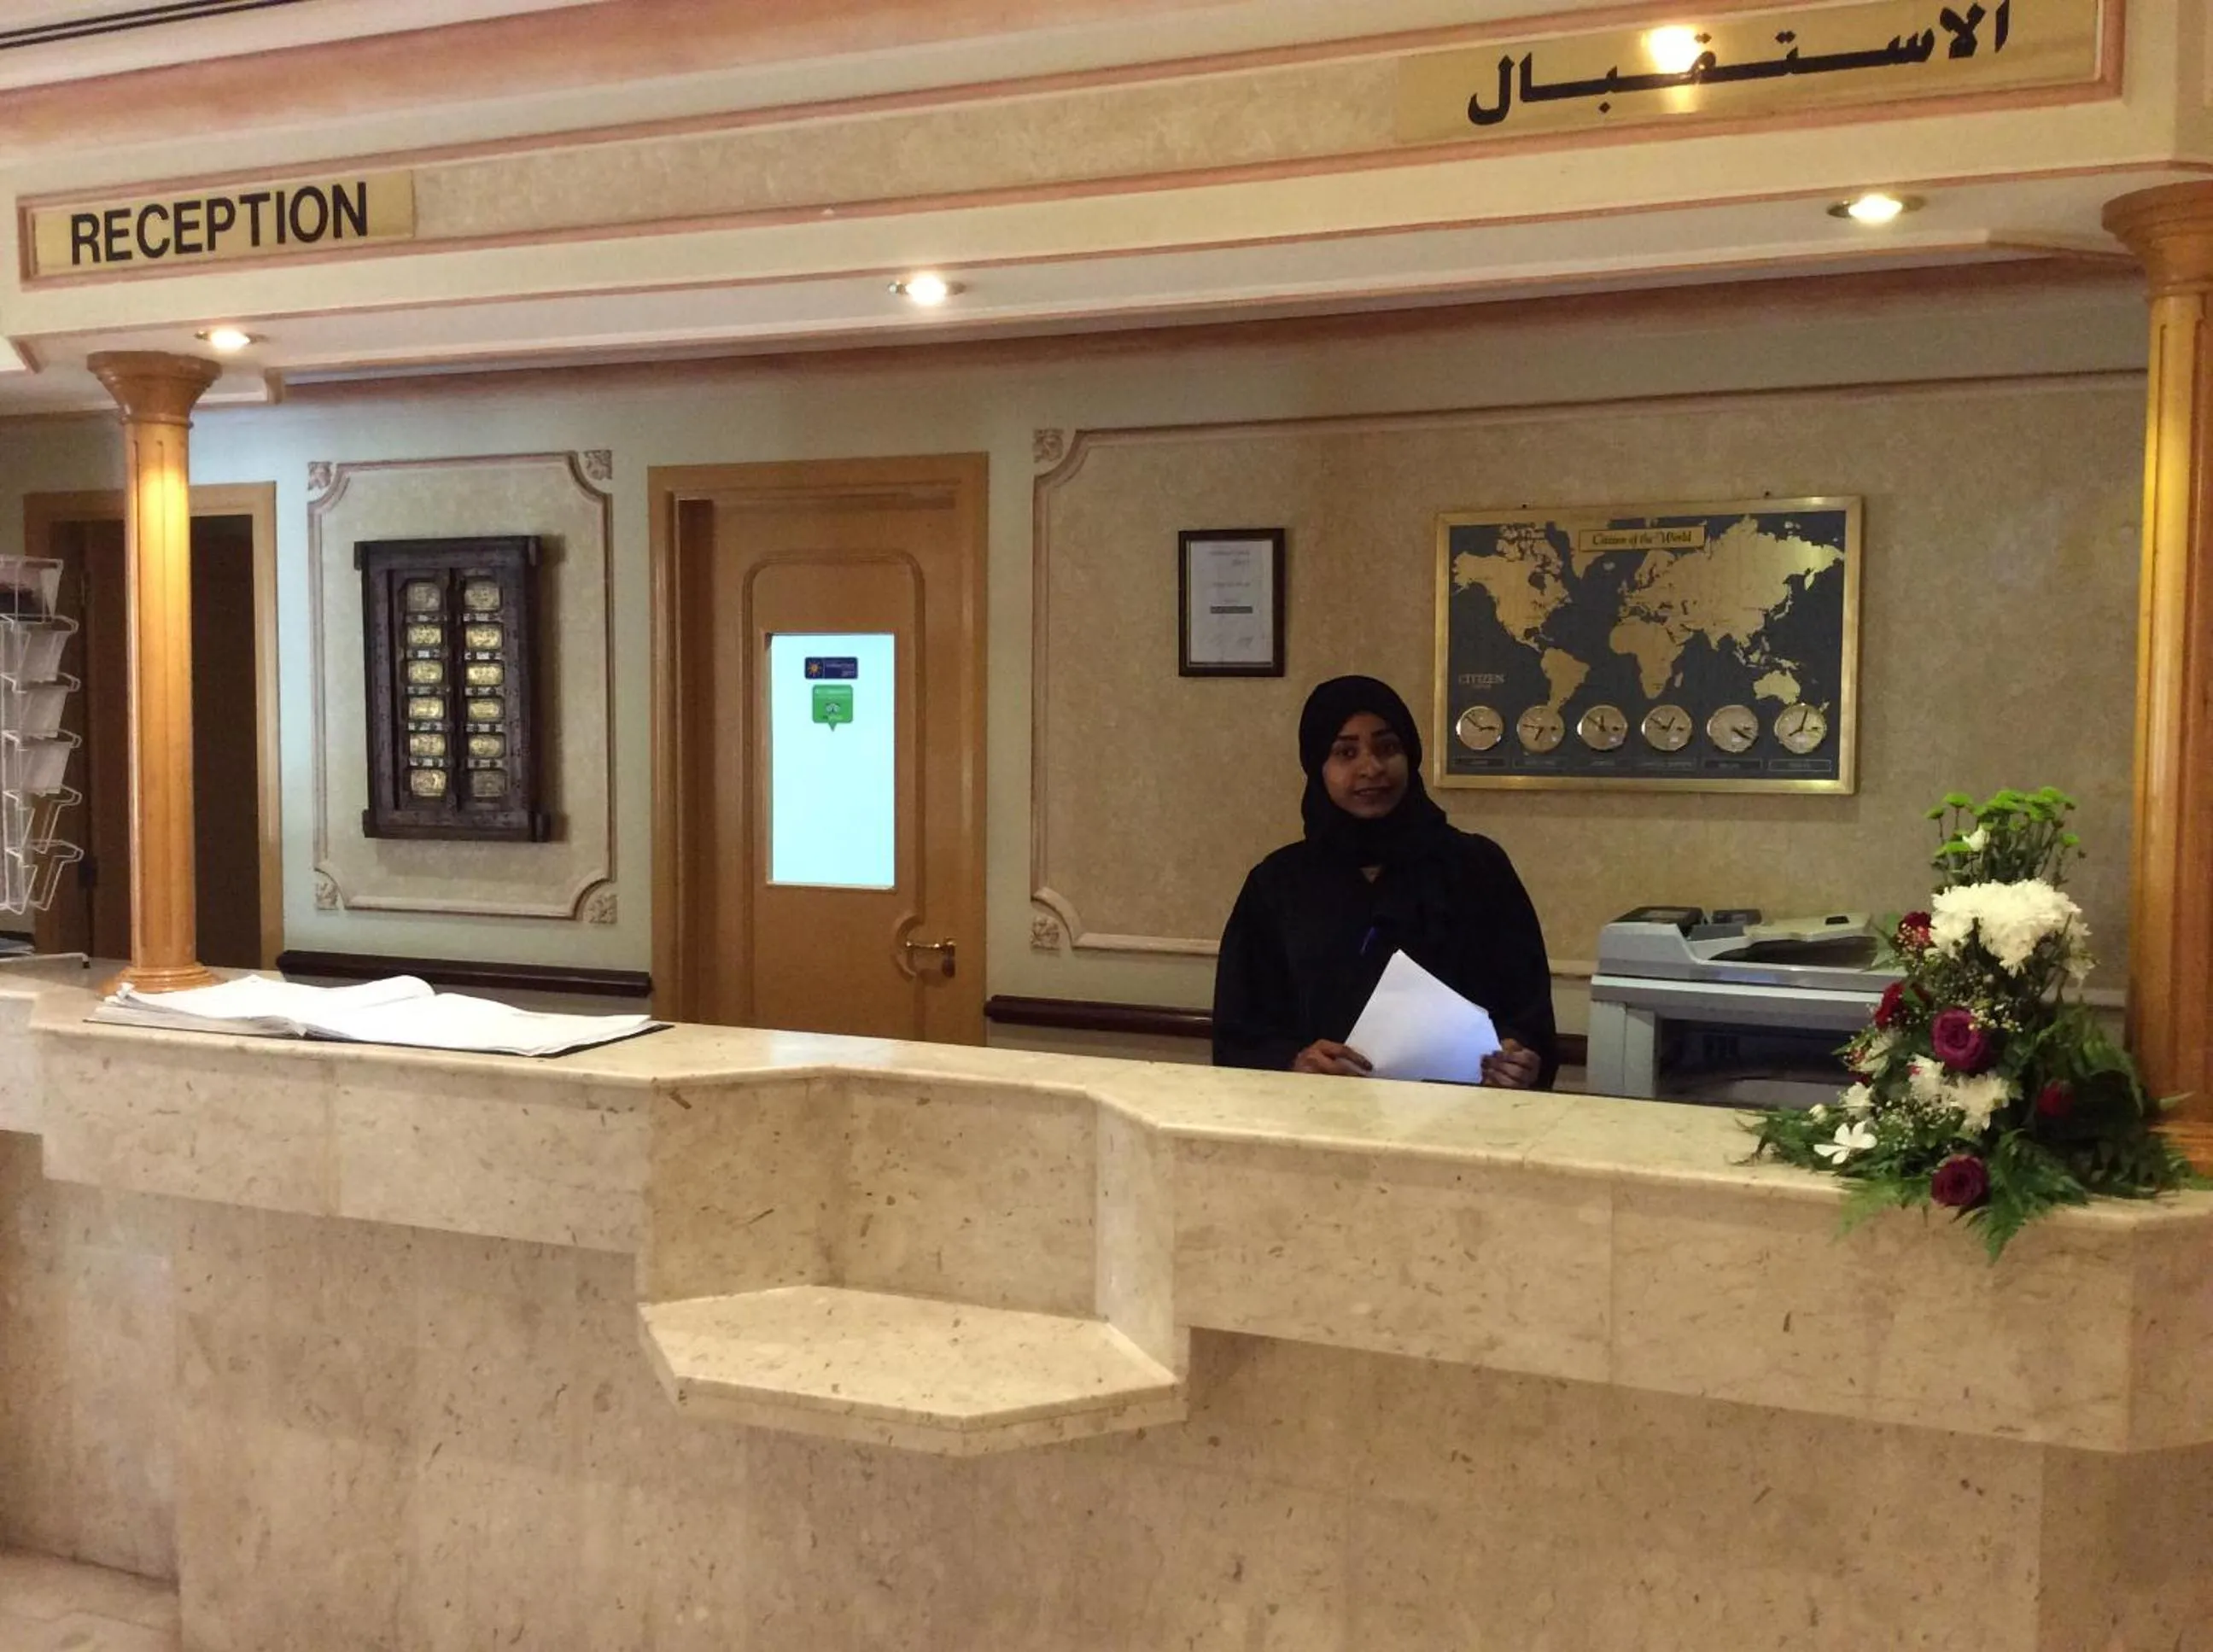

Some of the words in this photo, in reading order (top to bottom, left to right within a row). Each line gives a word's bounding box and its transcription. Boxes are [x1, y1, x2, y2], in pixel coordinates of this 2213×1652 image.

[1468, 0, 2010, 126] الاستقبال
[70, 181, 368, 266] RECEPTION
[1659, 530, 1692, 543] World
[1458, 674, 1504, 684] CITIZEN
